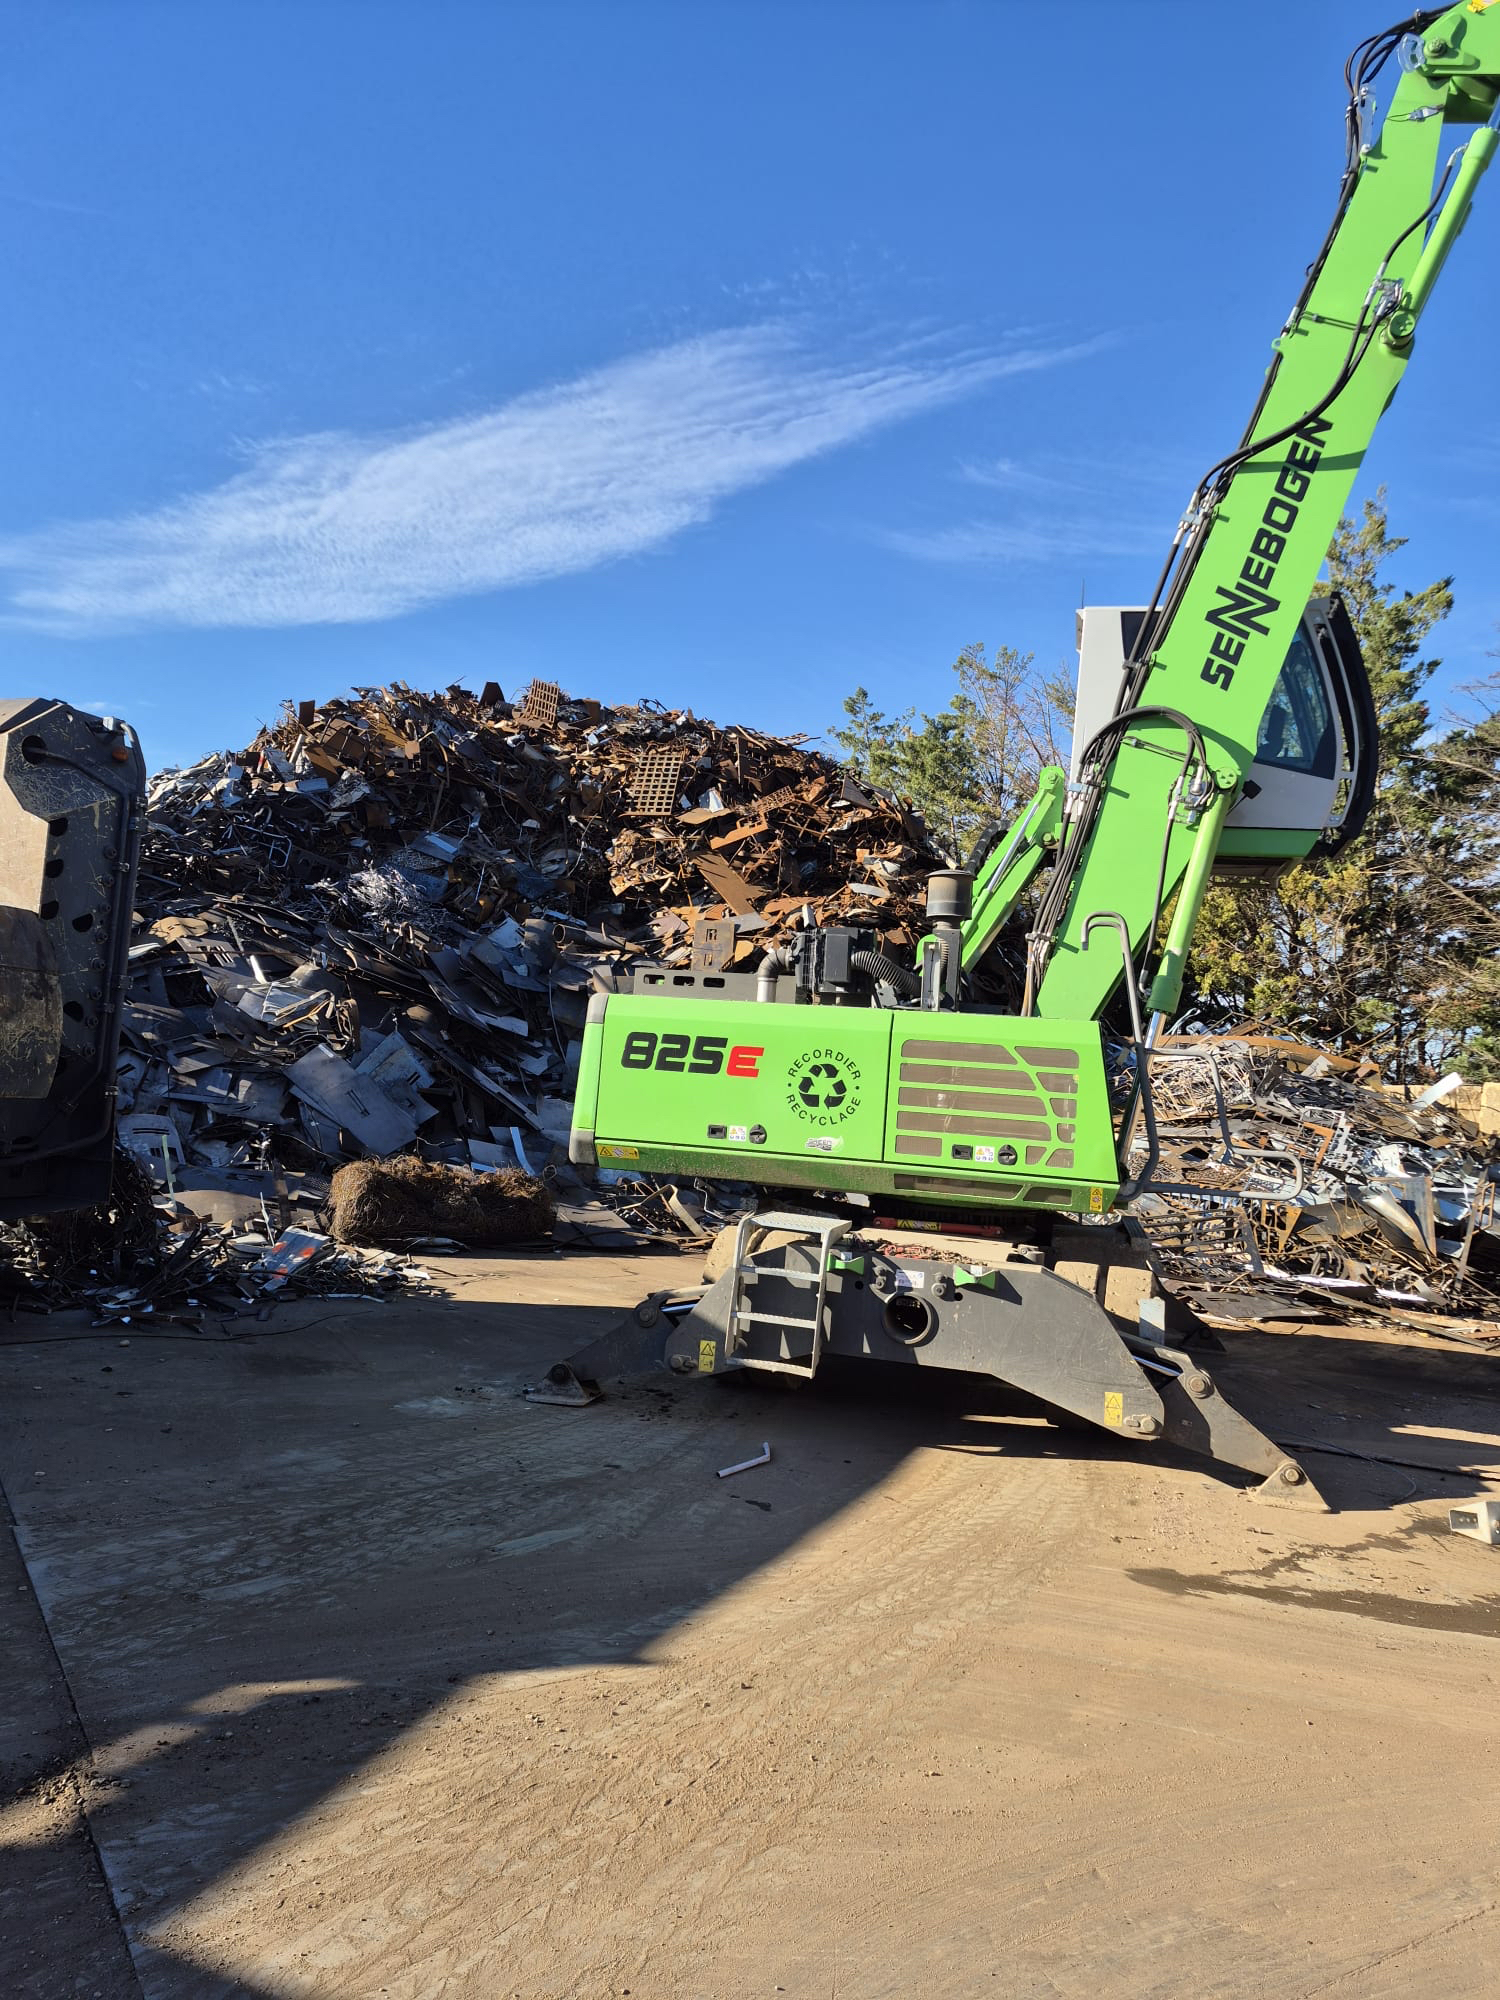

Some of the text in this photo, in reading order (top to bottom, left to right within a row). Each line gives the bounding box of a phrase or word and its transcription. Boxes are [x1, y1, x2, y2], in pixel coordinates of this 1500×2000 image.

[1200, 411, 1334, 692] SENNEBOGEN
[621, 1031, 765, 1079] 825E
[788, 1048, 861, 1081] RECORDIER
[786, 1094, 861, 1126] RECYCLAGE
